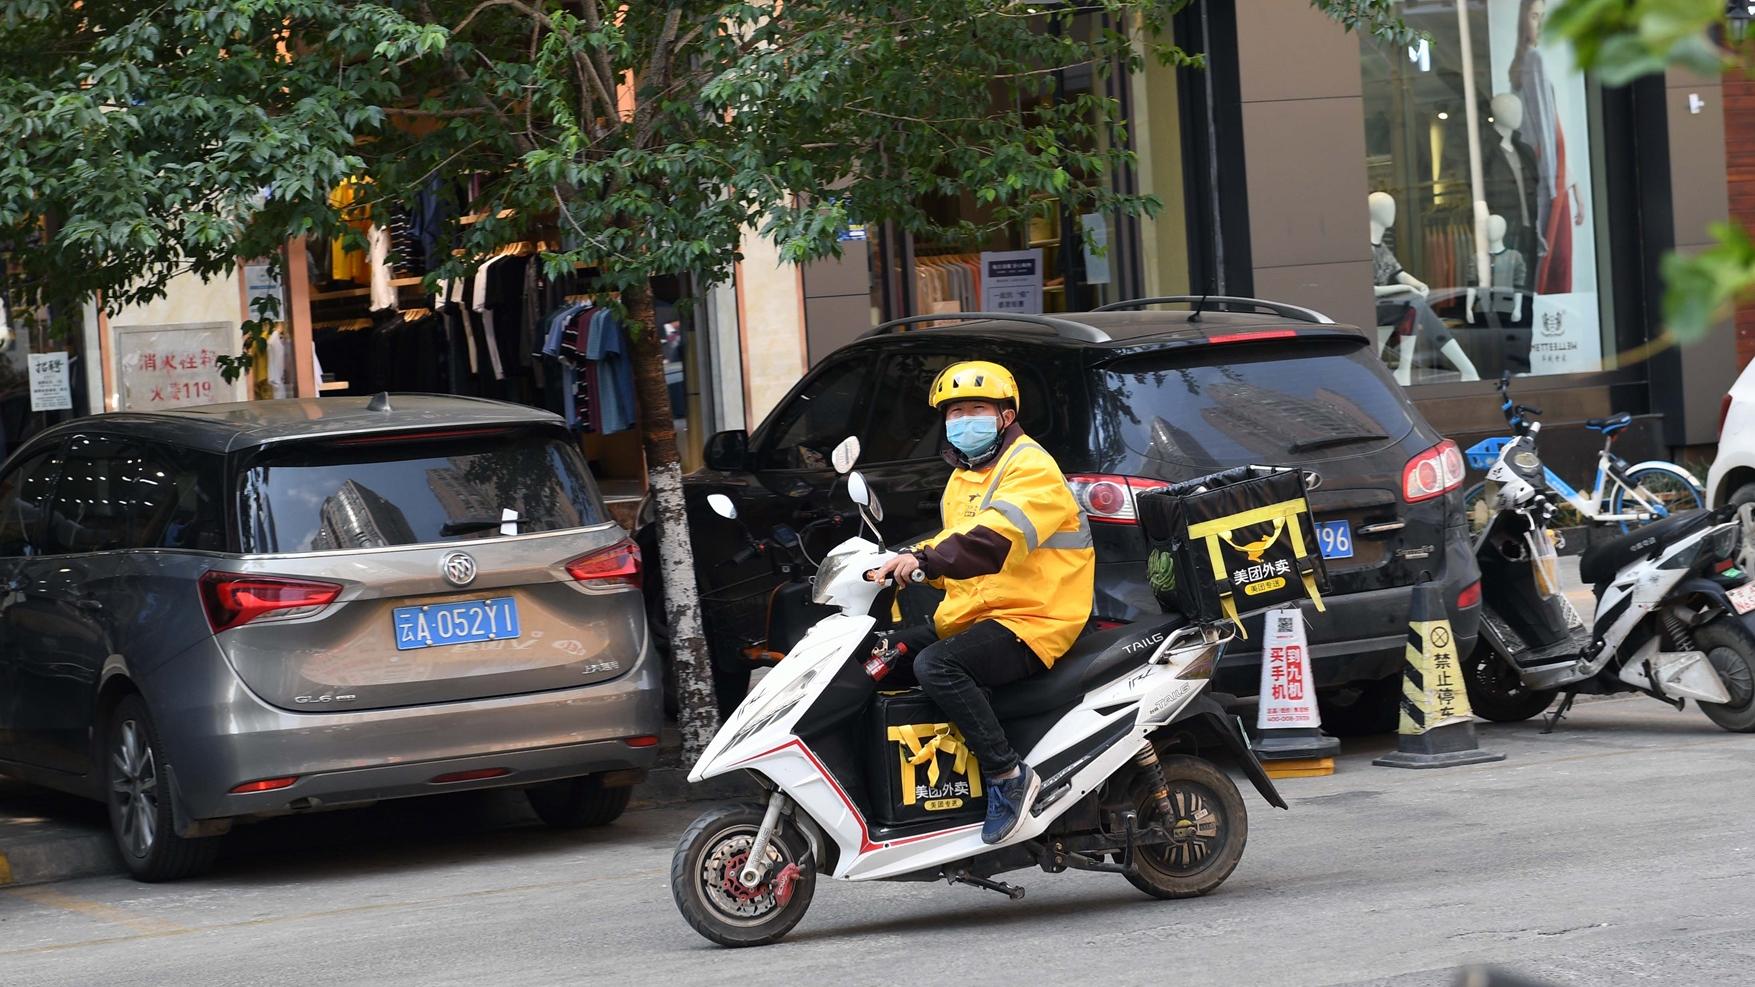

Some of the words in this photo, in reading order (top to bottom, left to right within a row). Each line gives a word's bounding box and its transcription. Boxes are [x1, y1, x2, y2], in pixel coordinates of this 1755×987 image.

[35, 360, 64, 373] 招聘
[1317, 527, 1349, 552] 96
[1233, 559, 1291, 585] 美团外卖
[1251, 580, 1281, 593] 美团专送
[1122, 632, 1164, 654] TAILG
[1270, 647, 1286, 700] 买手机
[1287, 648, 1302, 698] 到九机
[1434, 653, 1455, 717] 禁止停车
[295, 695, 332, 704] GL6
[1155, 682, 1191, 709] TAILG
[915, 781, 969, 799] 美团外卖
